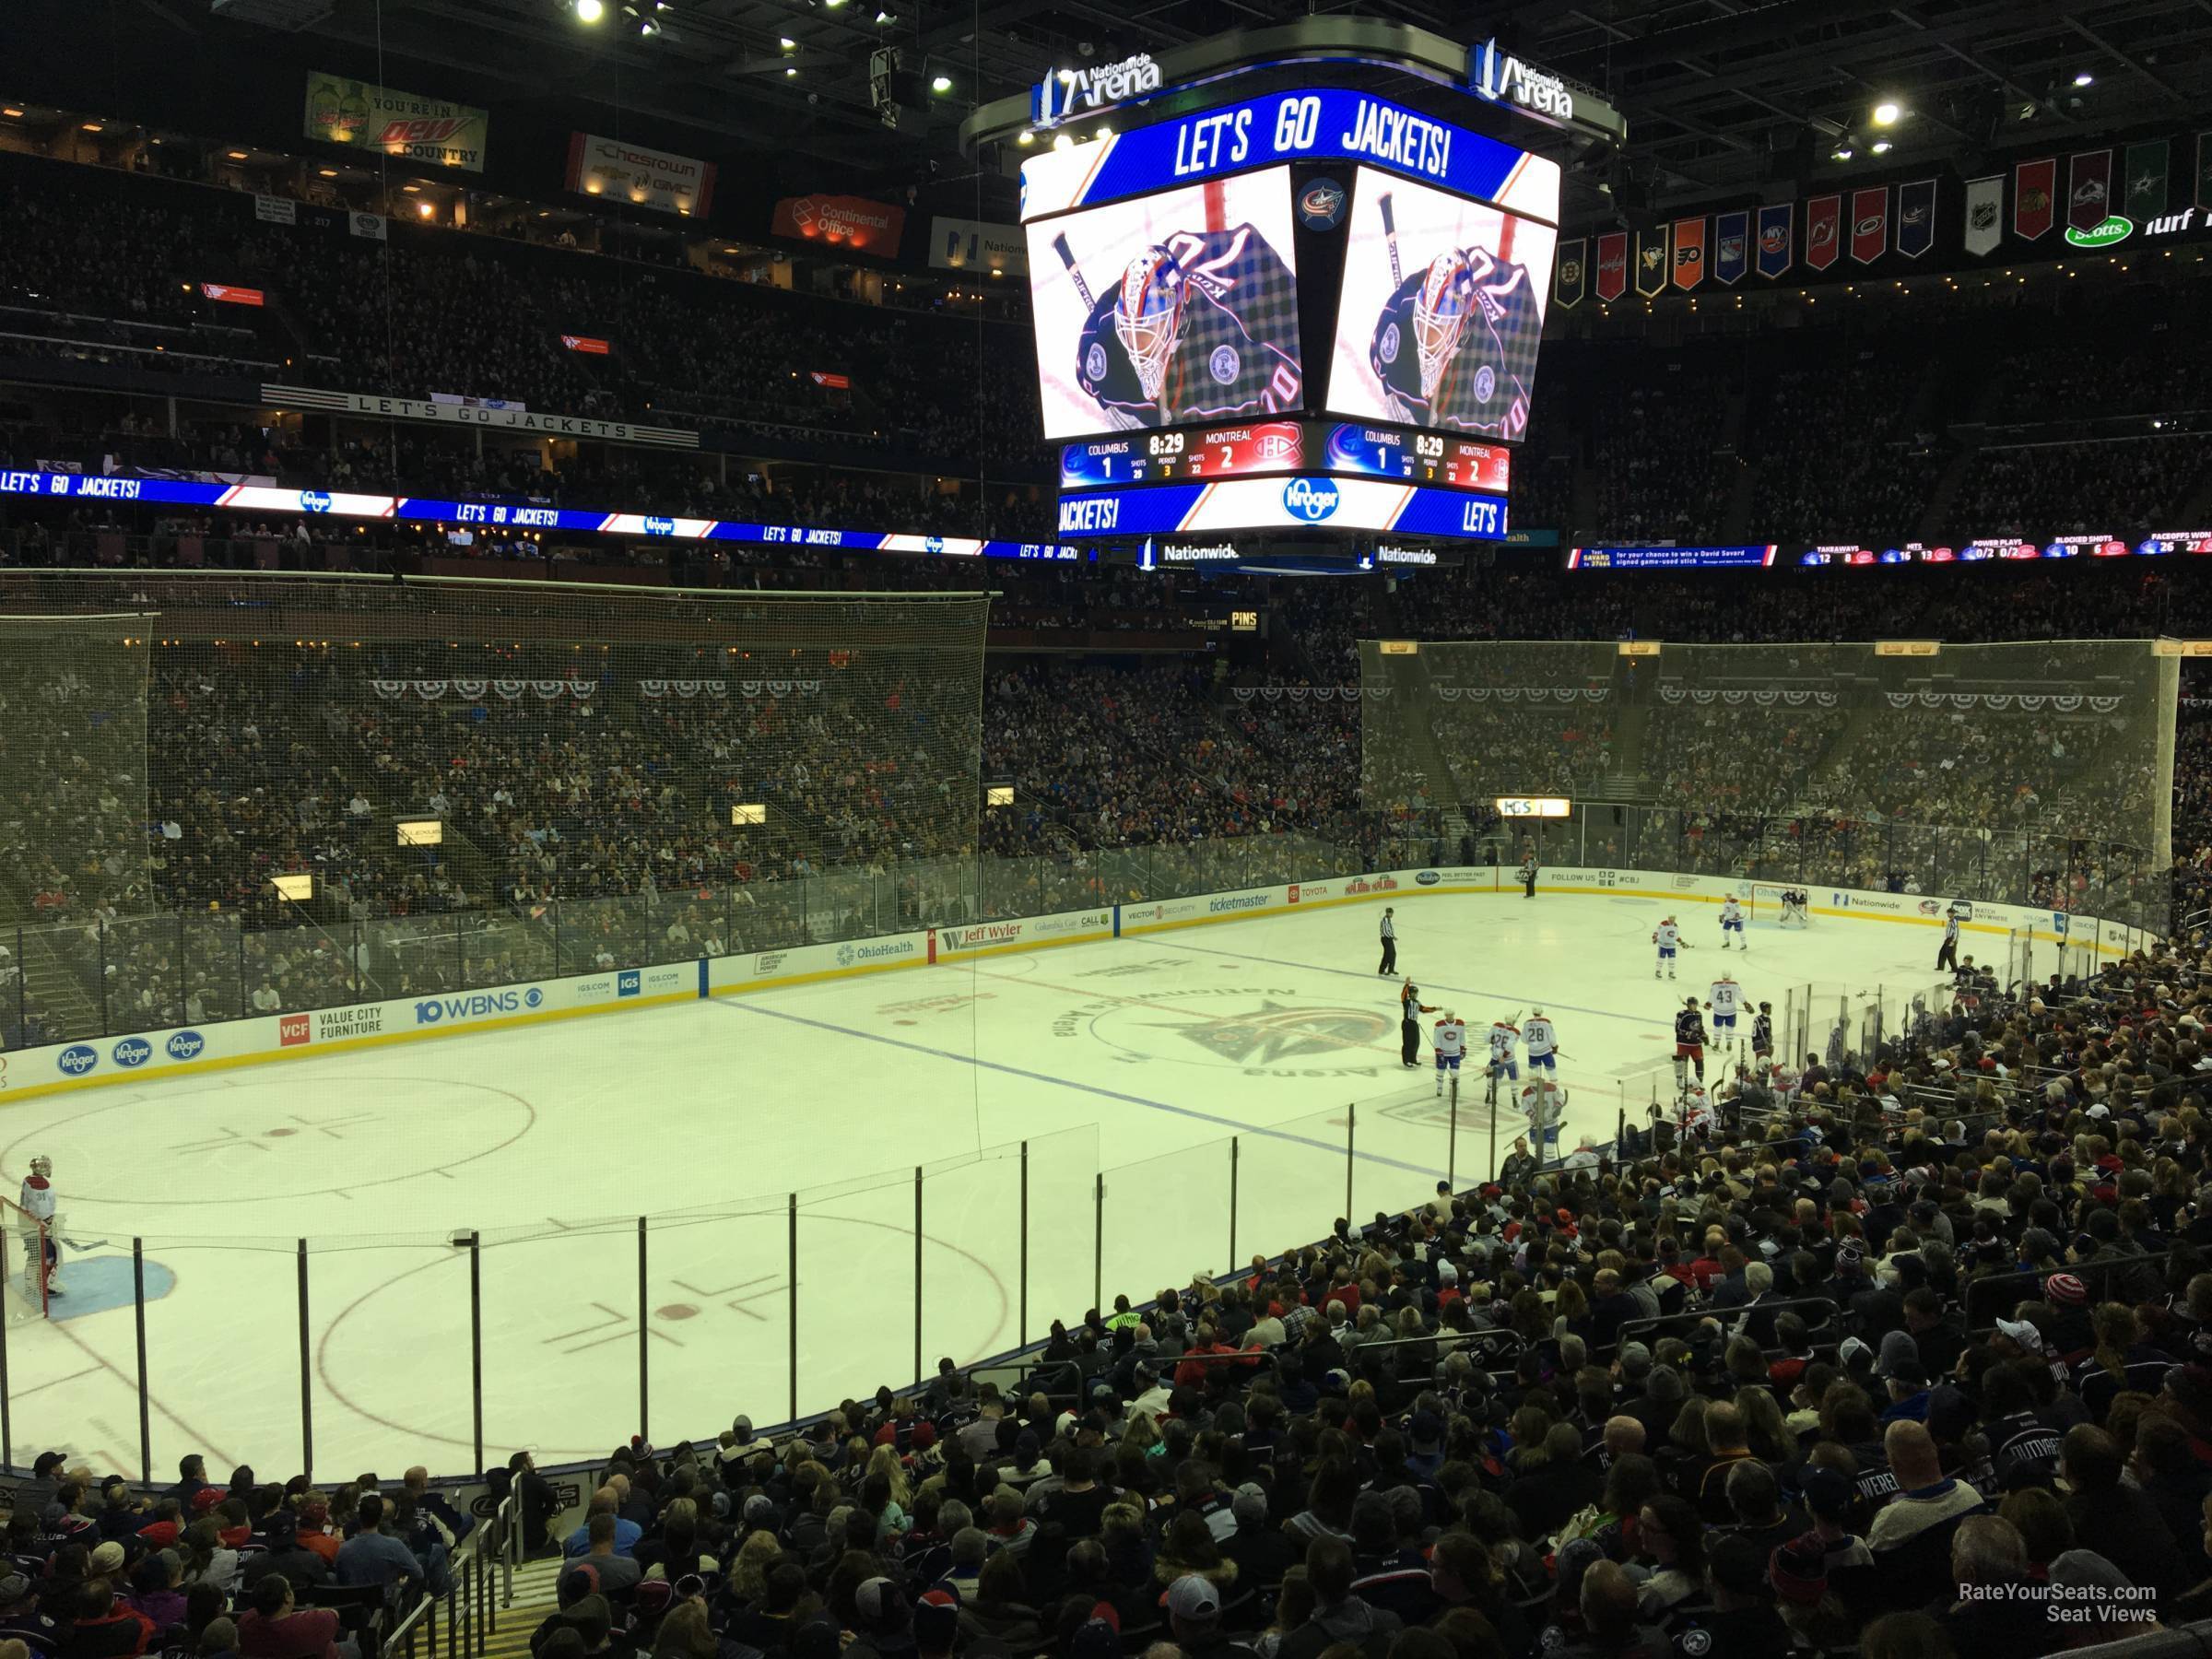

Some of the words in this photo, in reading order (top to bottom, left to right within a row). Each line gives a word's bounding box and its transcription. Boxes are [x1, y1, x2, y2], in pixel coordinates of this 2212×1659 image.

[1090, 53, 1151, 81] Nationwide
[1518, 63, 1564, 91] Nationwide
[1063, 63, 1161, 114] Arena
[1500, 56, 1572, 118] Arena
[373, 98, 429, 117] YOU'RE
[434, 106, 451, 118] IN
[1174, 108, 1252, 176] LET'S
[1275, 96, 1321, 152] GO
[1343, 100, 1453, 178] JACKETS!
[403, 144, 477, 163] COUNTRY
[653, 178, 692, 195] GMC
[820, 203, 889, 229] Continental
[818, 218, 854, 237] Office
[358, 397, 437, 417] LET'S
[458, 408, 490, 423] GO
[506, 413, 627, 437] JACKETS
[1088, 442, 1129, 456] COLUMBUS
[1150, 433, 1184, 455] 8:29
[1206, 429, 1253, 444] MONTREAL
[1365, 430, 1401, 446] COLUMBUS
[1417, 435, 1443, 457] 8:29
[1460, 445, 1491, 459] MONTREAL
[1131, 459, 1147, 468] SHOTS
[1159, 457, 1177, 465] PERIOD
[1189, 454, 1206, 464] SHOTS
[1222, 446, 1233, 468] 2
[1379, 448, 1386, 469] 1
[1102, 458, 1112, 477] 1
[1165, 465, 1171, 477] 3
[1192, 464, 1202, 475] 22
[1428, 467, 1434, 478] 3
[1449, 472, 1456, 480] 22
[1471, 461, 1479, 481] 2
[1, 472, 40, 492] LET'S
[51, 475, 69, 493] GO
[77, 477, 141, 498] JACKETS!
[301, 491, 331, 511] Kroger
[1288, 481, 1338, 518] Kroger
[457, 504, 486, 523] LET'S
[494, 507, 507, 523] GO
[512, 508, 559, 526] JACKETS!
[1465, 501, 1499, 535] LET'S
[647, 517, 674, 535] Kroger
[764, 526, 787, 542] LET'S
[792, 528, 803, 543] GO
[807, 528, 841, 546] JACKETS!
[1020, 545, 1039, 558] LET'S
[1044, 546, 1053, 559] GO
[1164, 543, 1240, 561] Nationwide
[1380, 546, 1438, 564] Nationwide
[1817, 546, 1860, 554] TAKEAWAYS
[1900, 551, 1912, 560] 16
[1922, 550, 1933, 560] 13
[1977, 548, 1994, 559] 0/2
[2000, 547, 2018, 558] 0/2
[2065, 545, 2079, 556] 10
[2094, 545, 2101, 554] 6
[2160, 542, 2174, 552] 26
[2187, 541, 2201, 551] 27
[1819, 552, 1830, 563] 12
[1845, 552, 1851, 562] 8
[1232, 611, 1258, 626] PINS
[1552, 874, 1583, 882] FOLLOW
[1619, 876, 1640, 885] #CBJ
[1302, 887, 1328, 897] TOYOTA
[1210, 894, 1269, 912] ticketmaster
[1853, 898, 1900, 910] Nationwide
[1081, 915, 1100, 925] CALL
[1128, 911, 1155, 920] VECTOR
[1165, 905, 1195, 915] SECURITY
[965, 927, 988, 943] Jeff
[990, 924, 1023, 939] Wyler
[858, 941, 914, 959] OhioHealth
[621, 977, 639, 989] IGS
[649, 972, 678, 982] IGS.COM
[578, 982, 610, 993] IGS.COM
[1716, 990, 1733, 1003] 43
[320, 1009, 354, 1026] VALUE
[358, 1006, 382, 1021] CITY
[415, 1000, 442, 1024] 10
[445, 991, 519, 1019] WBNS
[282, 1023, 309, 1039] VCF
[320, 1020, 382, 1039] FURNITURE
[1528, 1027, 1545, 1042] 28
[117, 1043, 149, 1065] Kroger
[171, 1036, 203, 1057] Kroger
[62, 1051, 95, 1073] Kroger
[36, 1193, 46, 1202] 31
